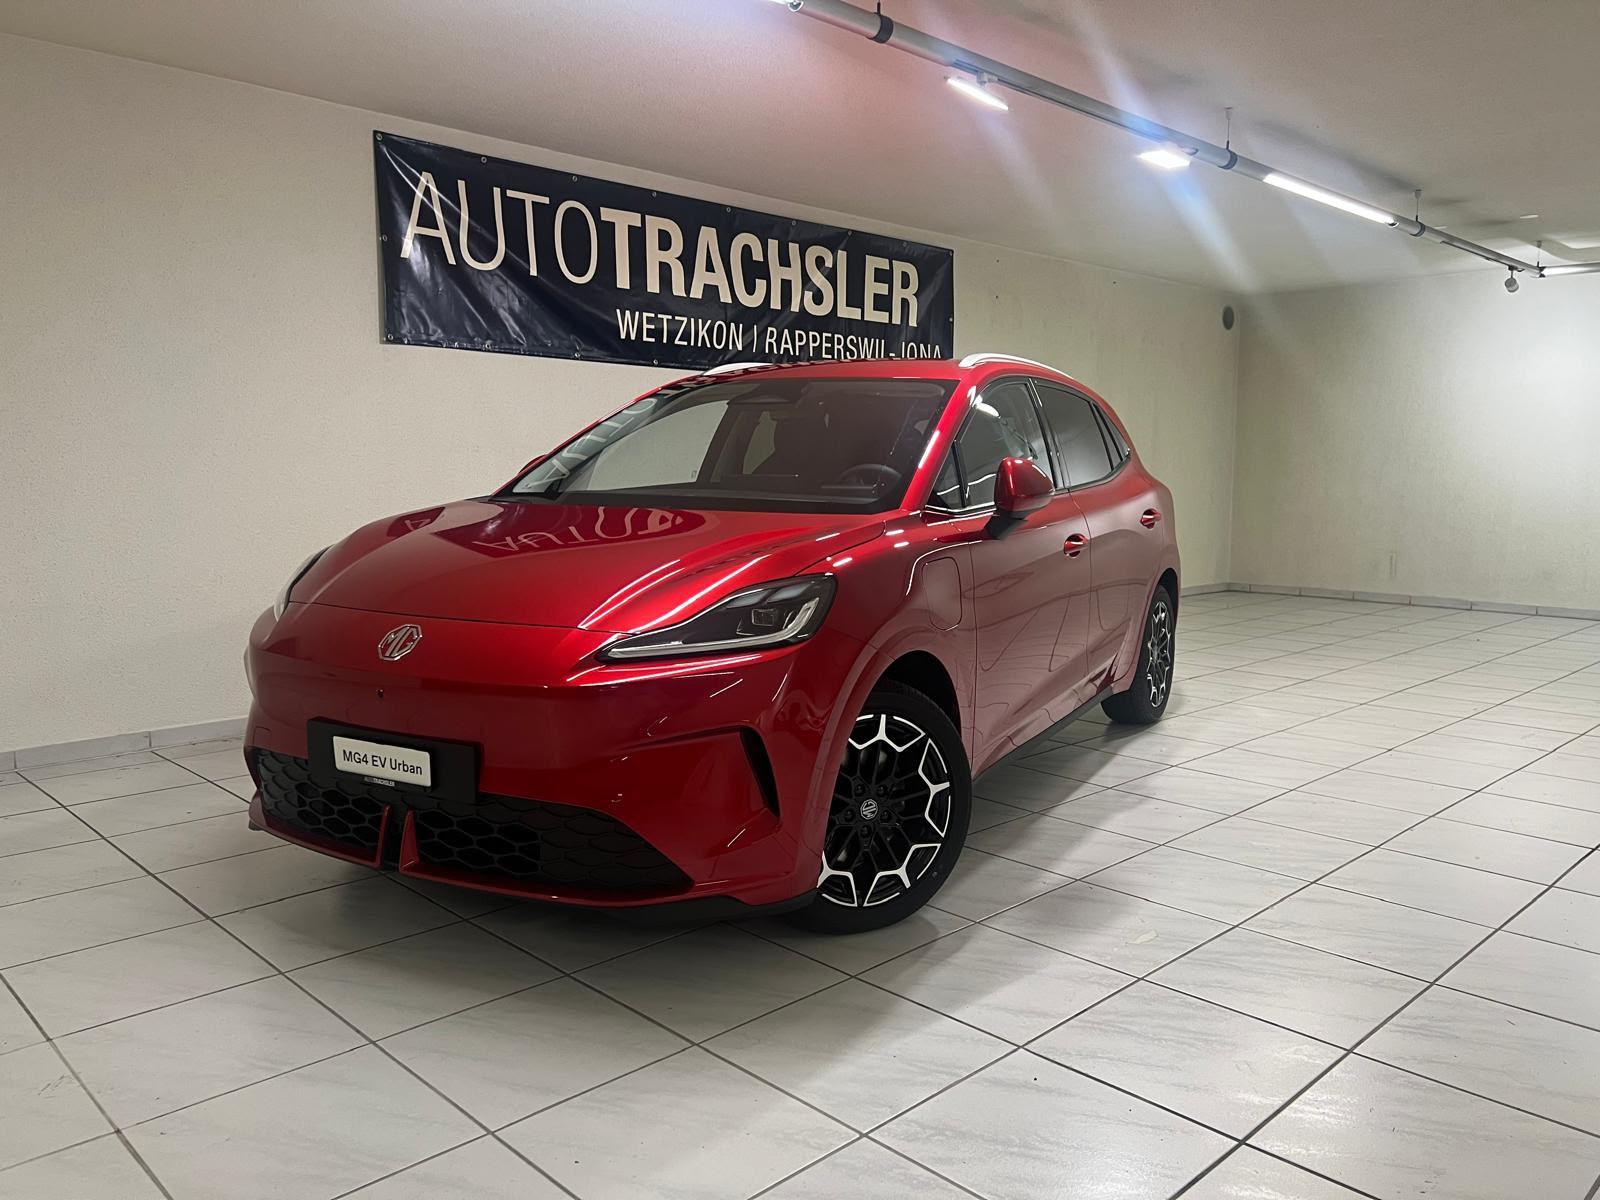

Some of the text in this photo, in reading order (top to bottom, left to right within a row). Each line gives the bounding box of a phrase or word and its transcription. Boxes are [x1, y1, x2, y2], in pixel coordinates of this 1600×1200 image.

[616, 308, 743, 351] WETZIKON
[378, 624, 422, 660] MG
[343, 749, 422, 775] MG4 EV Urban
